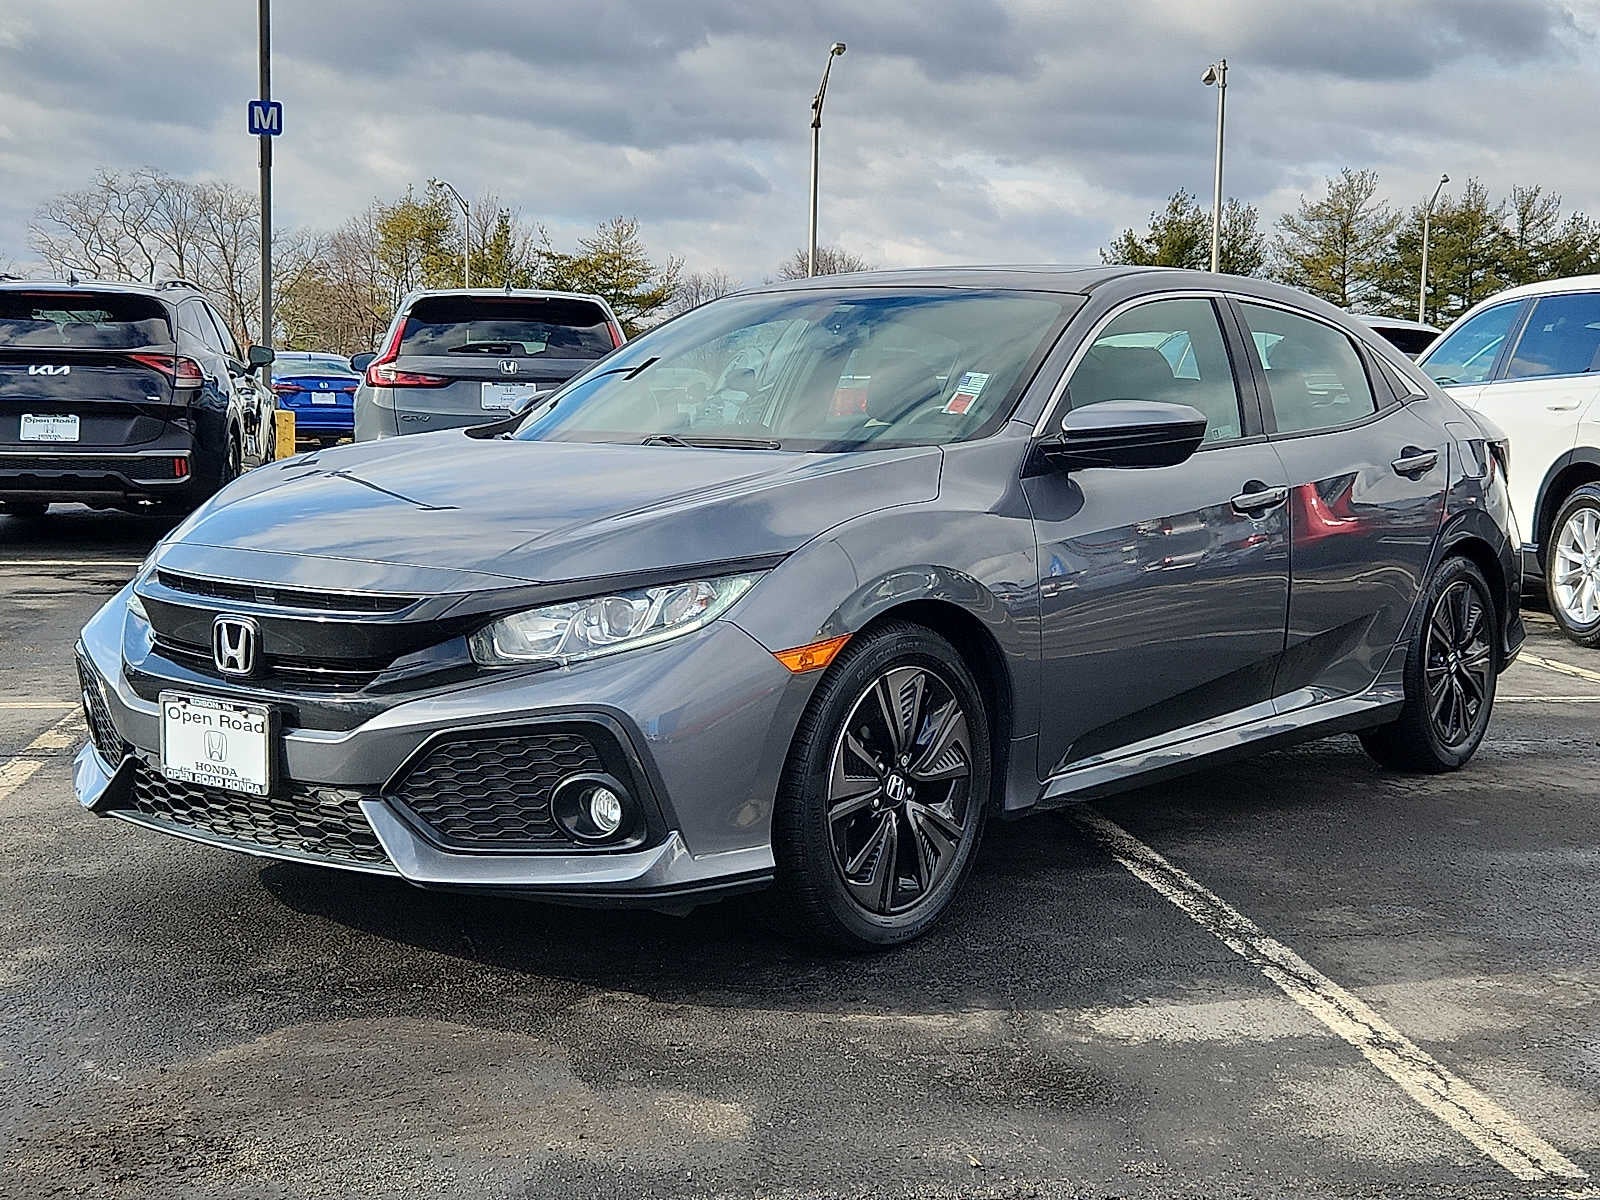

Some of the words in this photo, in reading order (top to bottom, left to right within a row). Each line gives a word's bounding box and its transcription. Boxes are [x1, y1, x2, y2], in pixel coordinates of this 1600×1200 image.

[254, 106, 277, 129] M
[28, 365, 70, 376] KIA
[168, 706, 213, 726] Open
[219, 714, 265, 734] Road
[195, 761, 239, 778] HONDA
[166, 768, 193, 783] OPEN
[194, 774, 224, 788] ROAD
[224, 780, 262, 795] HONDA
